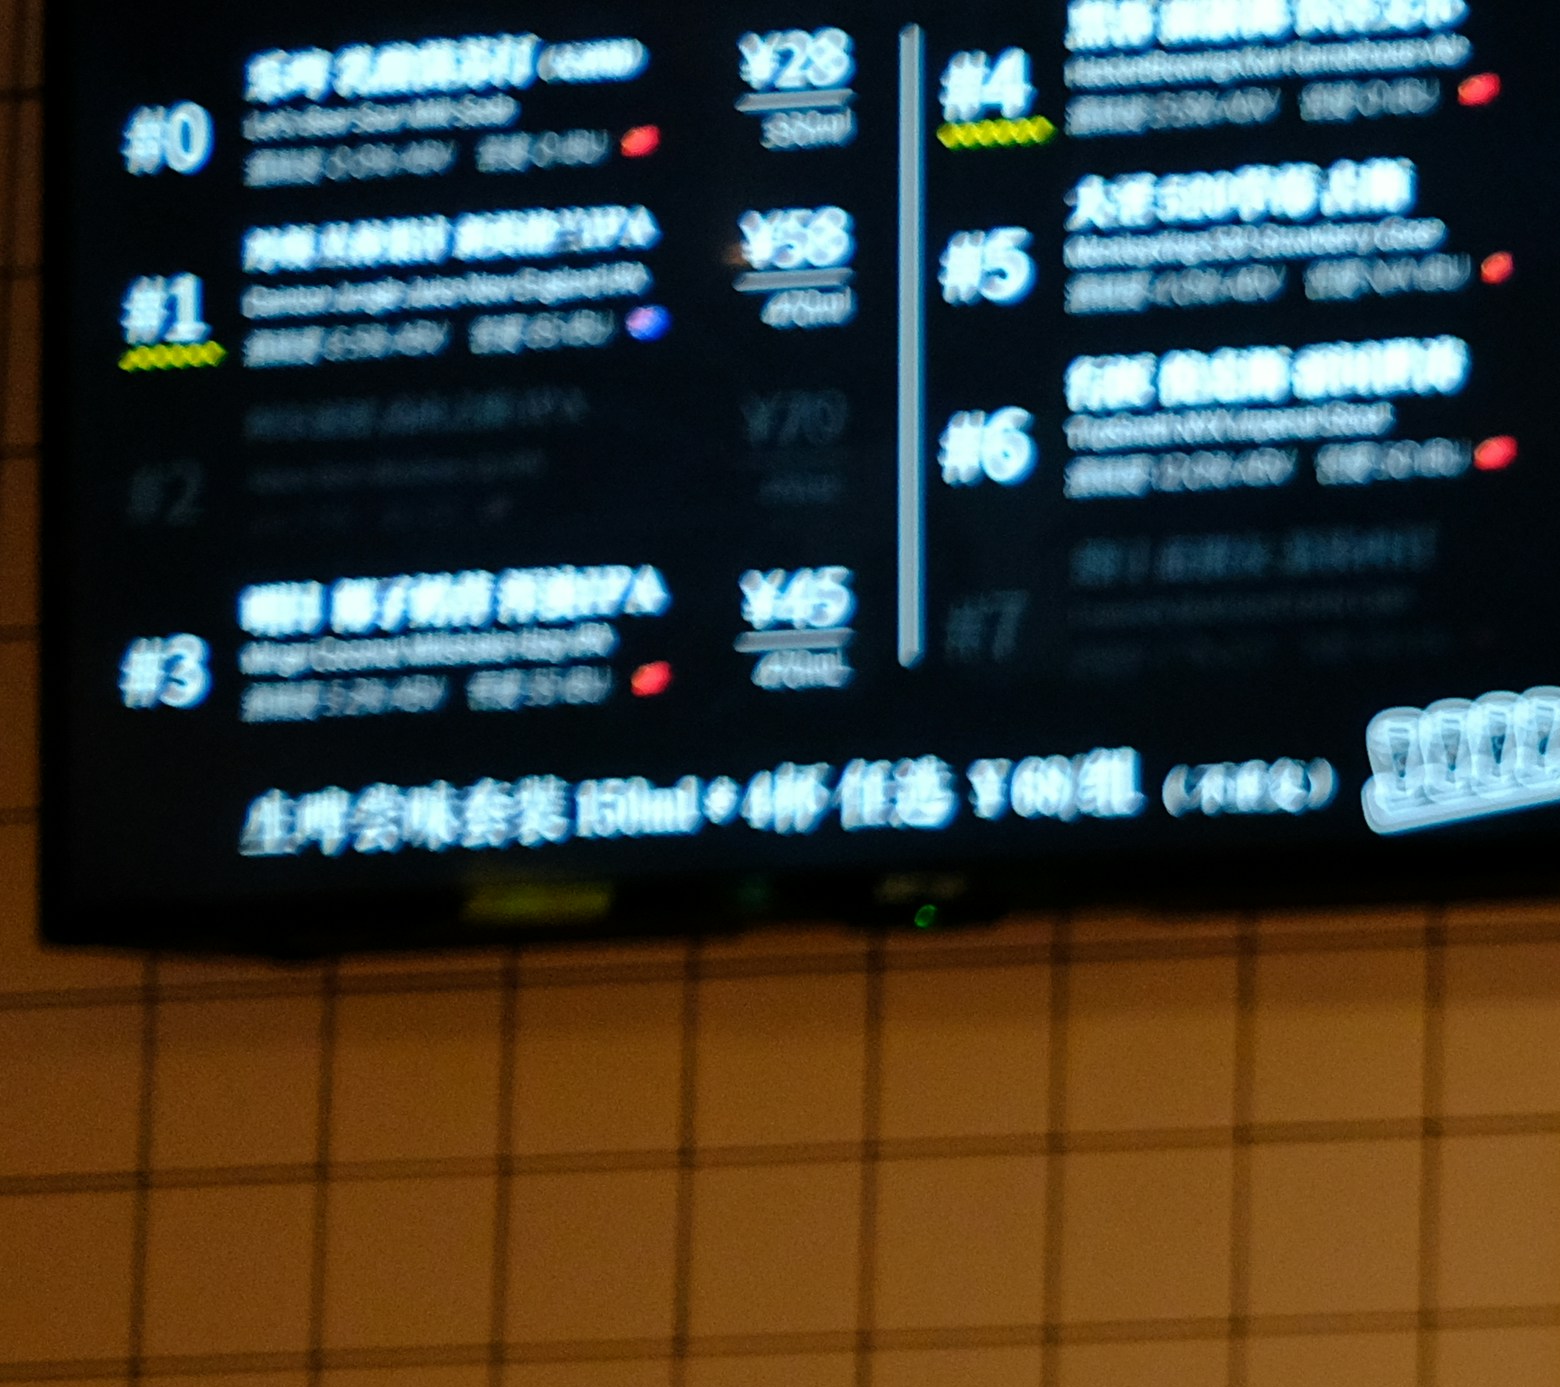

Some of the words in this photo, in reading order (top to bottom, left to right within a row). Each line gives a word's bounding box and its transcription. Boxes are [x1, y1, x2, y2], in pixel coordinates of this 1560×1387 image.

[939, 48, 1045, 125] #4
[123, 102, 211, 173] #0
[938, 227, 1034, 303] #5
[122, 273, 215, 345] #1
[938, 406, 1036, 484] #6
[120, 634, 209, 707] #3
